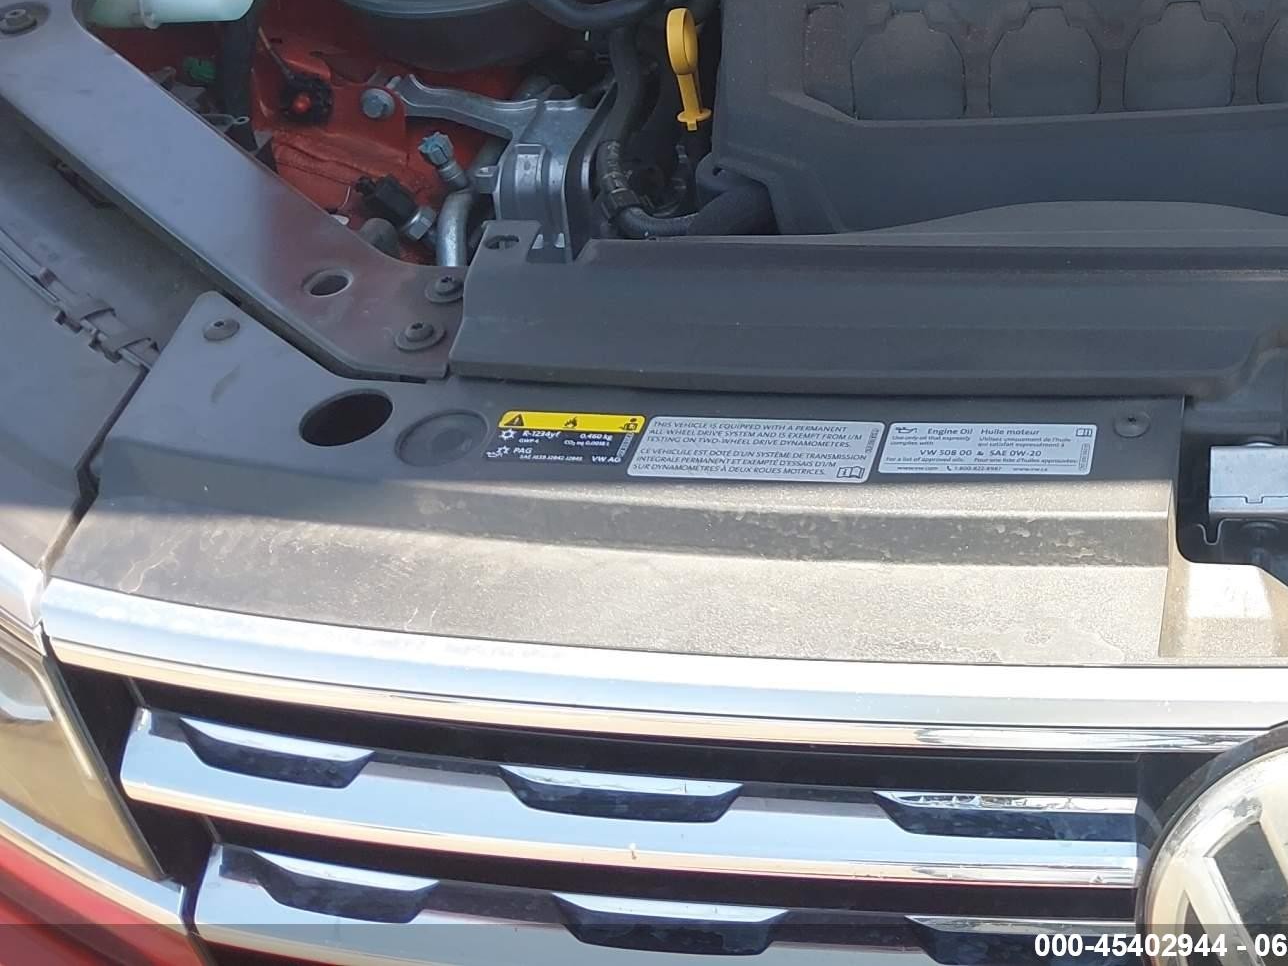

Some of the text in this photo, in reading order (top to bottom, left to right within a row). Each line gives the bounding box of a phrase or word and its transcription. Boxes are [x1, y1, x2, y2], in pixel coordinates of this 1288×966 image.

[522, 430, 562, 439] R-1234yf
[928, 427, 959, 435] Engine
[805, 452, 867, 461] TRANSMISSION
[680, 457, 730, 465] PERMANENT
